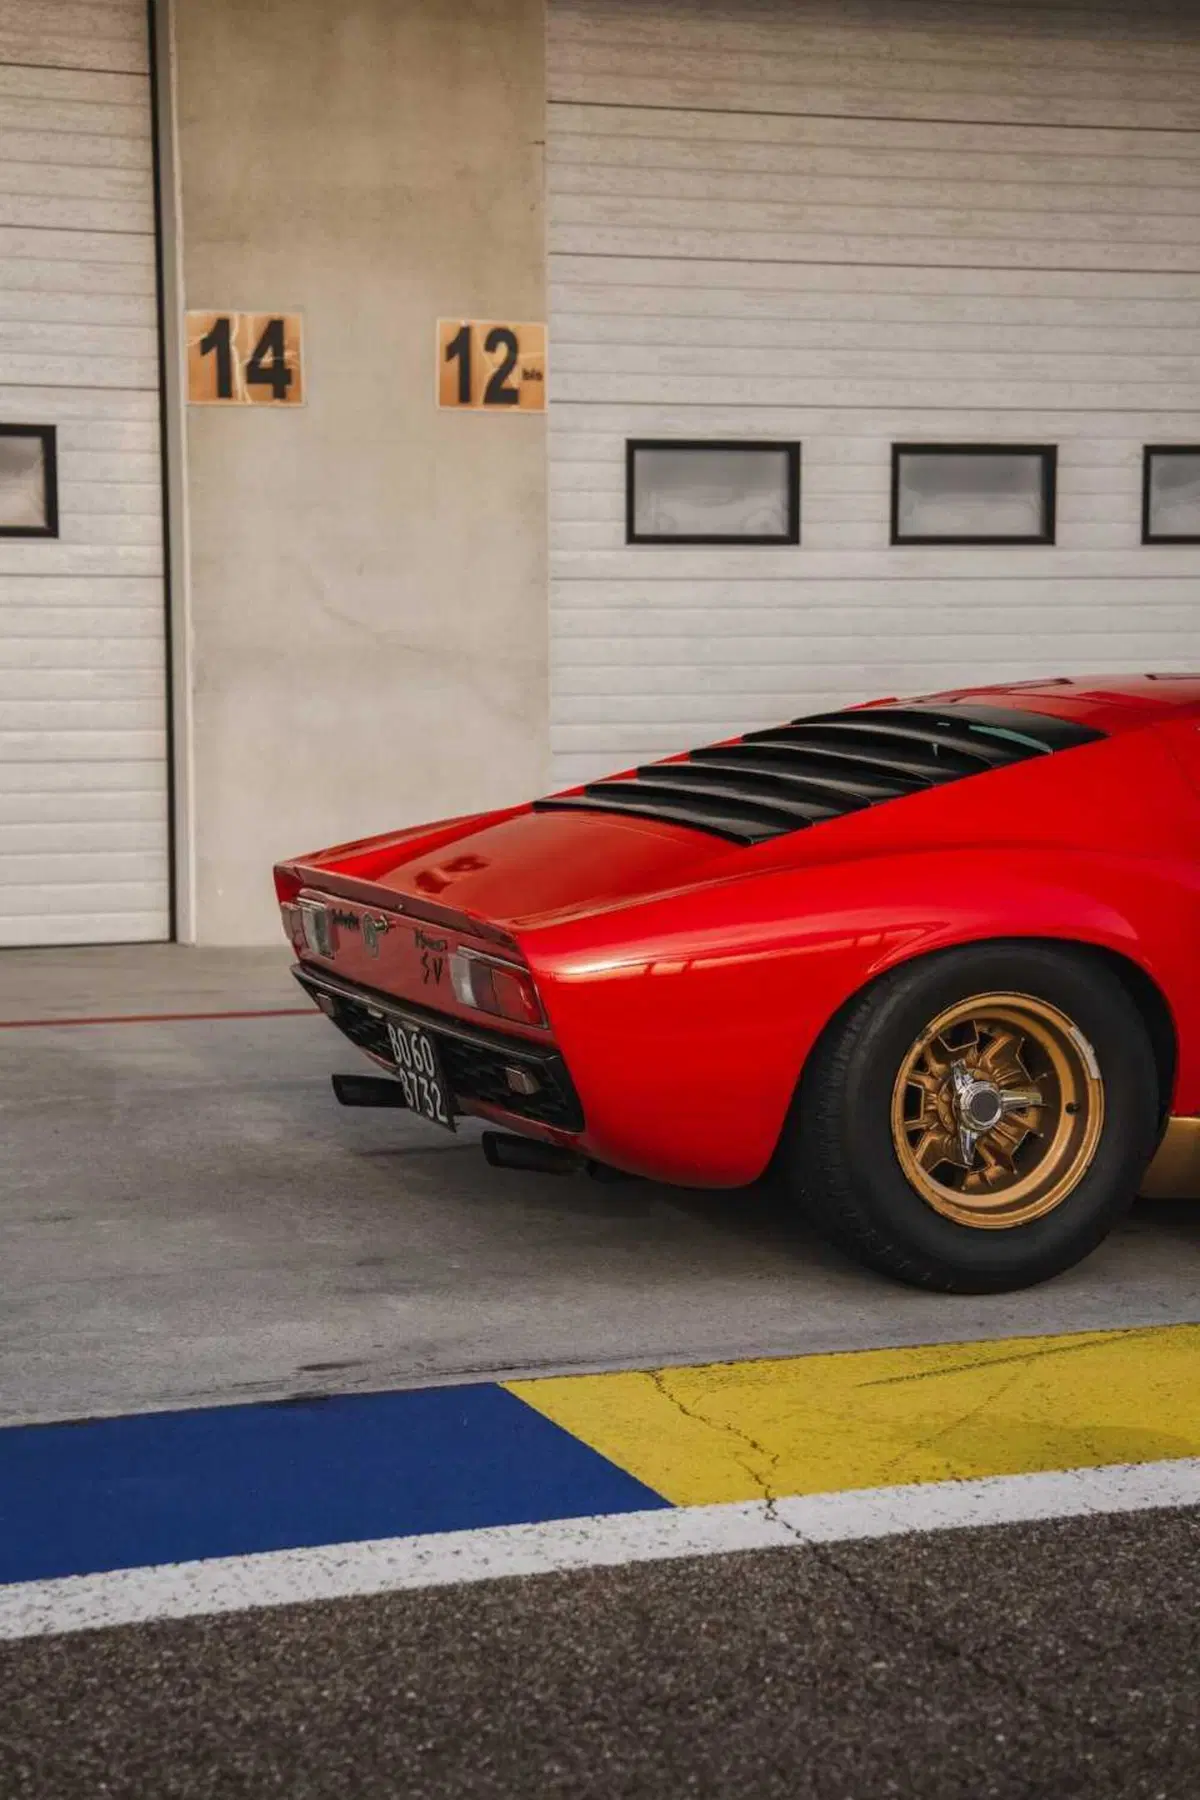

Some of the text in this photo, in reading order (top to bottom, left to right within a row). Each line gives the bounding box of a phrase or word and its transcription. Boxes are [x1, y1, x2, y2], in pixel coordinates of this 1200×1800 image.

[200, 317, 292, 400] 14
[445, 326, 520, 405] 12
[421, 951, 443, 985] SV
[388, 1023, 435, 1078] 8060
